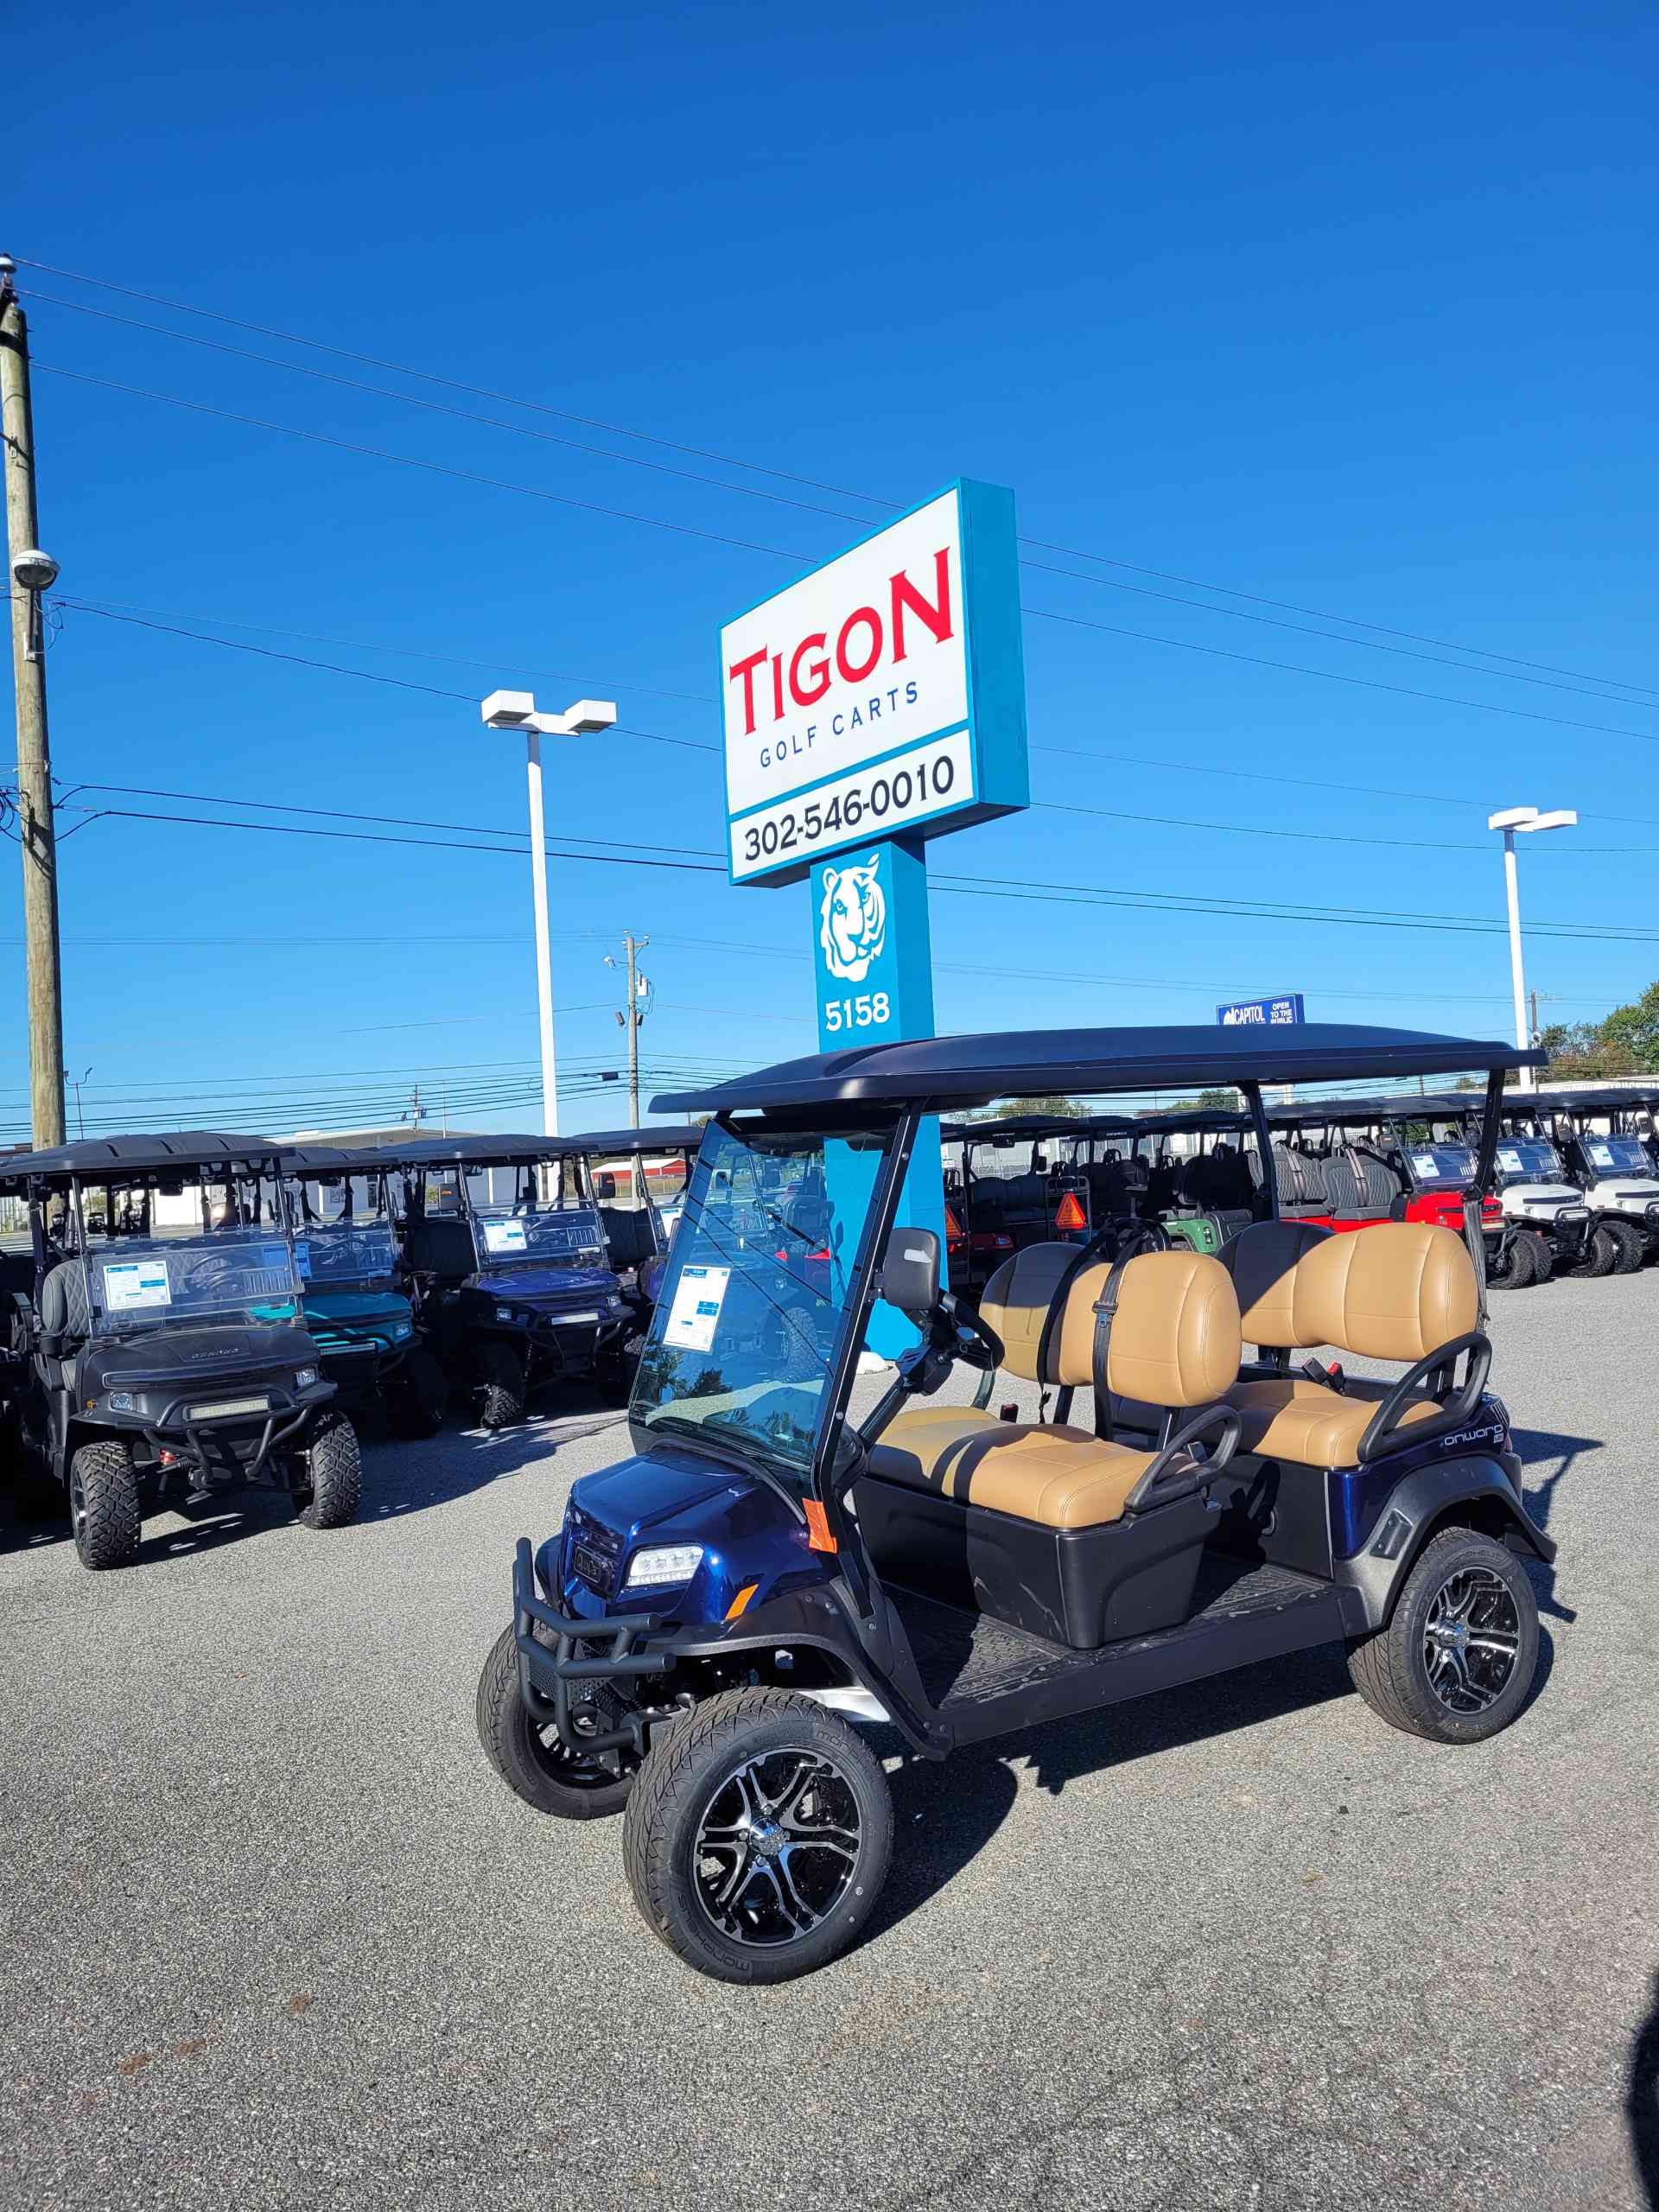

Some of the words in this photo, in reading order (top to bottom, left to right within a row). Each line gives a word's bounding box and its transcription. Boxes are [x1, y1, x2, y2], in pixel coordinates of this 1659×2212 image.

[729, 546, 955, 736] TIGON
[760, 725, 817, 768] GOLF
[832, 681, 918, 735] CARTS
[744, 755, 955, 861] 302-546-0010
[825, 992, 891, 1032] 5158
[1234, 1005, 1266, 1025] CAPITOL
